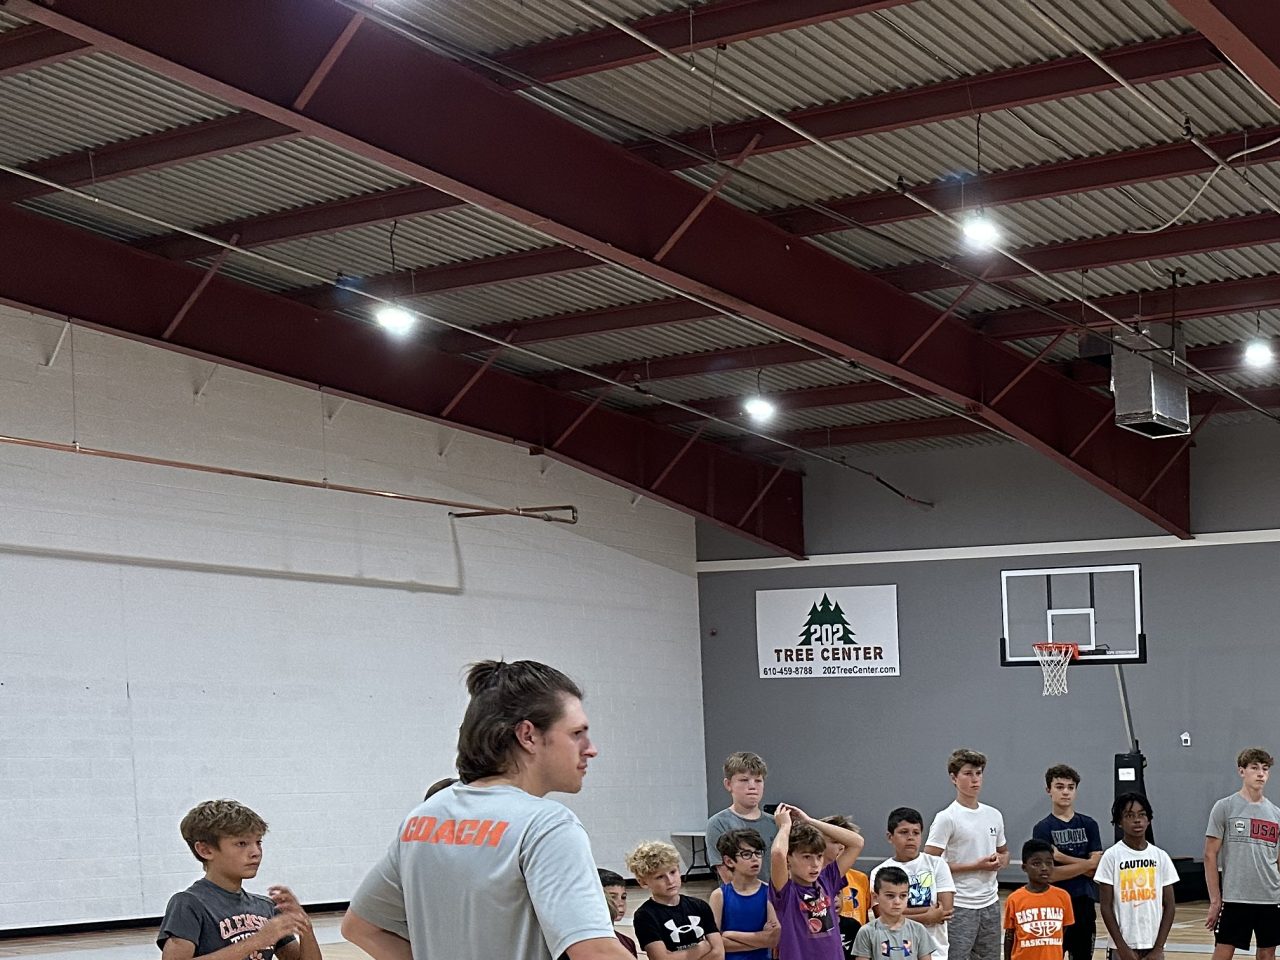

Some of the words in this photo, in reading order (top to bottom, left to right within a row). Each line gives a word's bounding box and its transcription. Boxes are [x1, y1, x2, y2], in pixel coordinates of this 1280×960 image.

[810, 624, 844, 646] 202
[774, 648, 814, 662] TREE
[821, 646, 883, 661] CENTER
[763, 666, 813, 676] 610-459-8788
[822, 665, 896, 675] 202TreeCenter.com
[401, 815, 509, 848] COACH
[1253, 823, 1276, 838] USA
[1120, 859, 1157, 870] CAUTION:
[1121, 867, 1156, 889] HOT
[1121, 888, 1156, 902] HANDS
[1015, 908, 1038, 924] EAST
